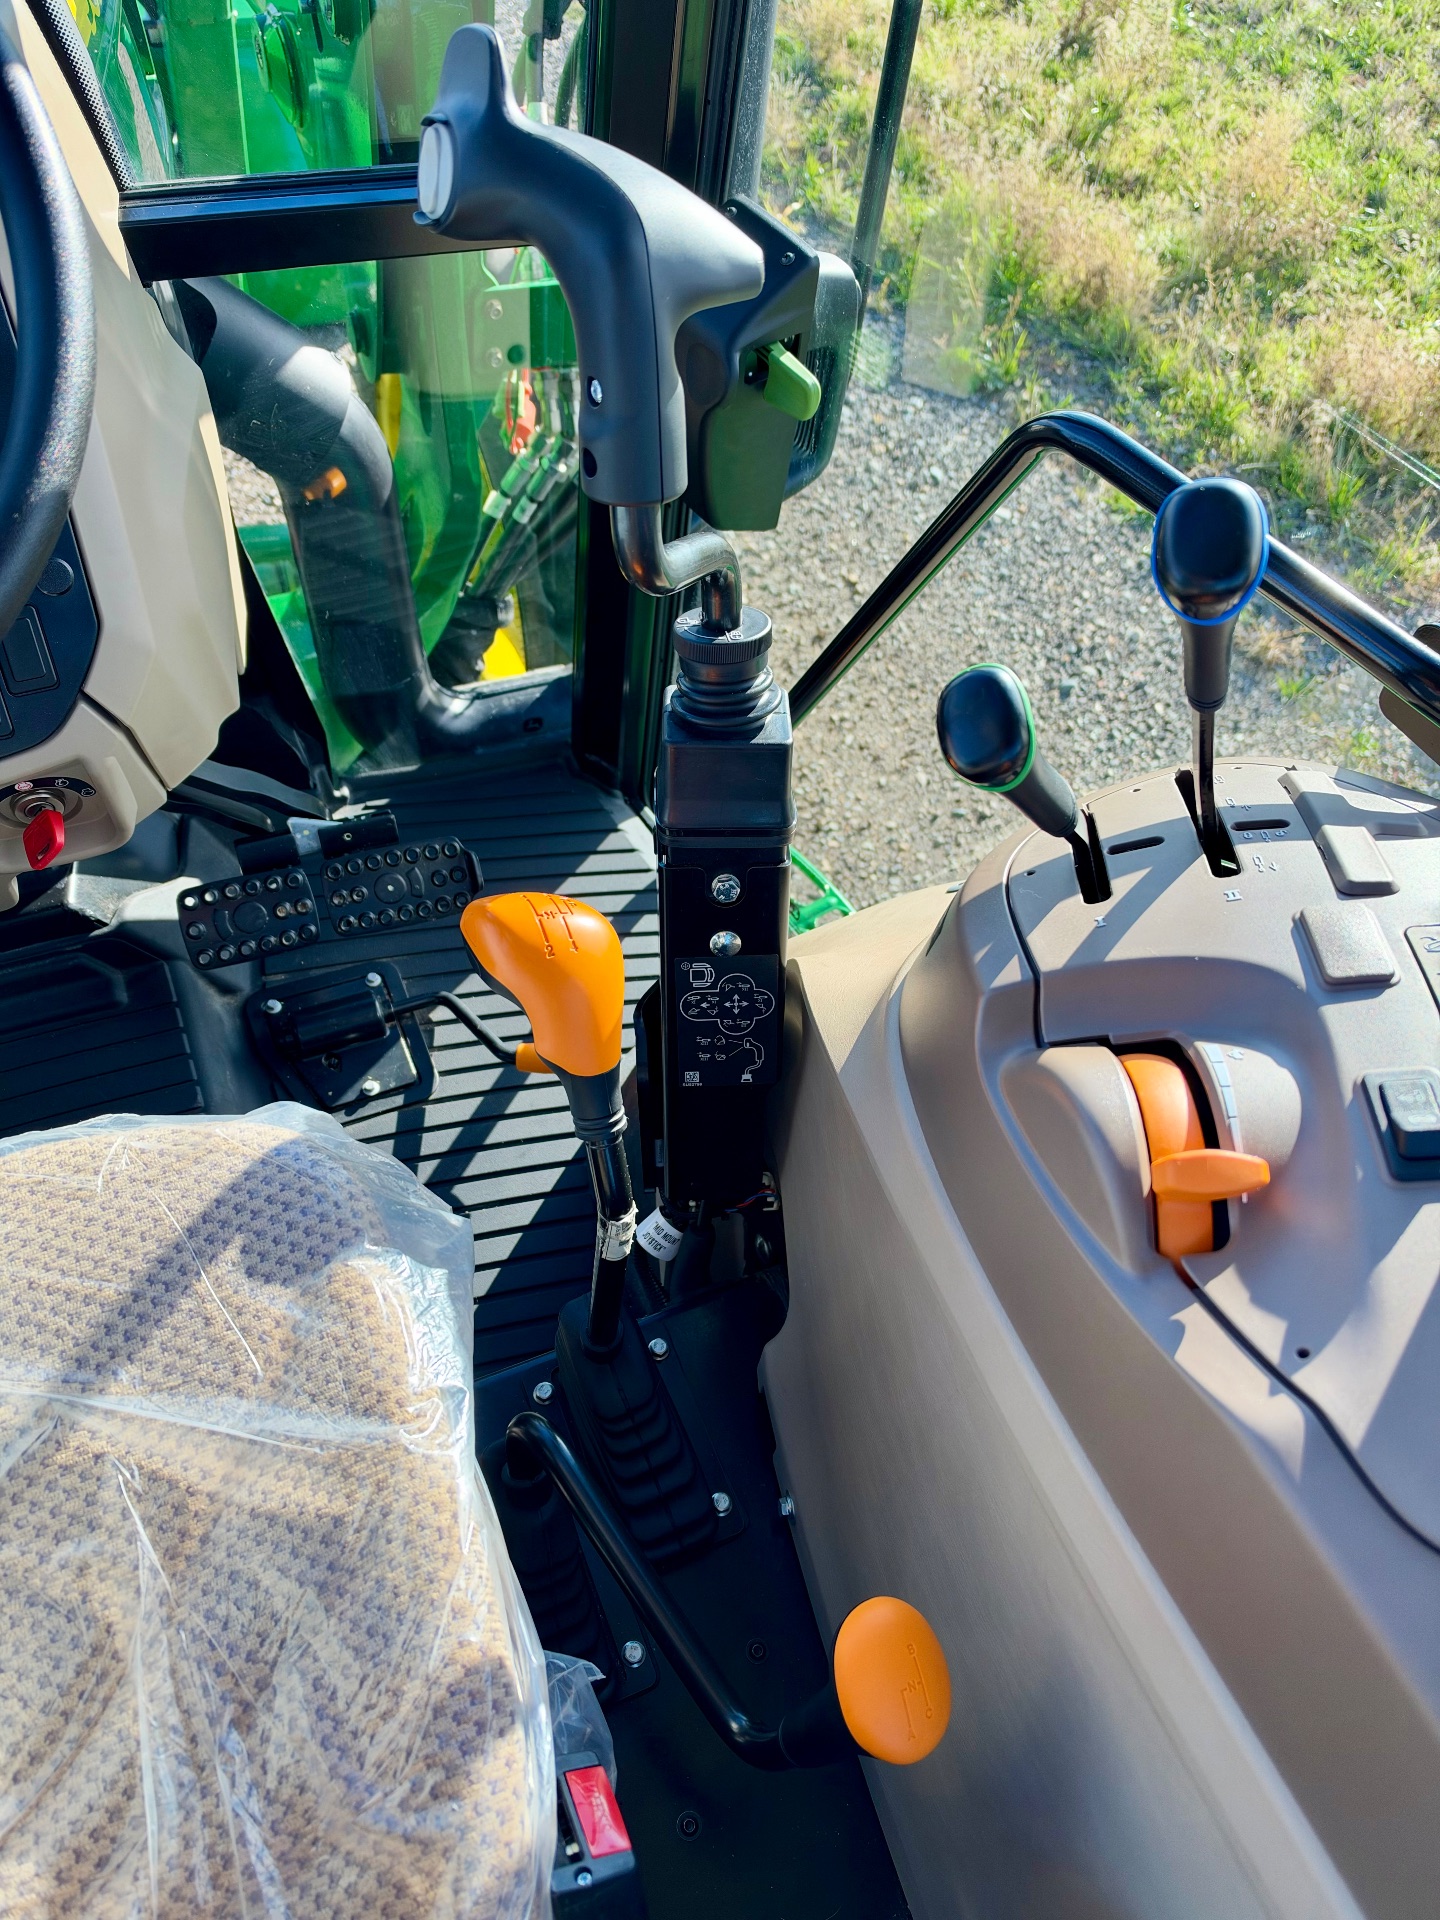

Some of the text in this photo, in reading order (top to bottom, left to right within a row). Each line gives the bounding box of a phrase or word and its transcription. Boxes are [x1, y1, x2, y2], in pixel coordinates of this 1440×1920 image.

[545, 944, 556, 958] 2
[660, 1231, 681, 1246] MOUNT
[906, 1643, 916, 1656] B
[907, 1680, 917, 1693] N
[925, 1707, 933, 1719] C
[907, 1726, 917, 1742] A
